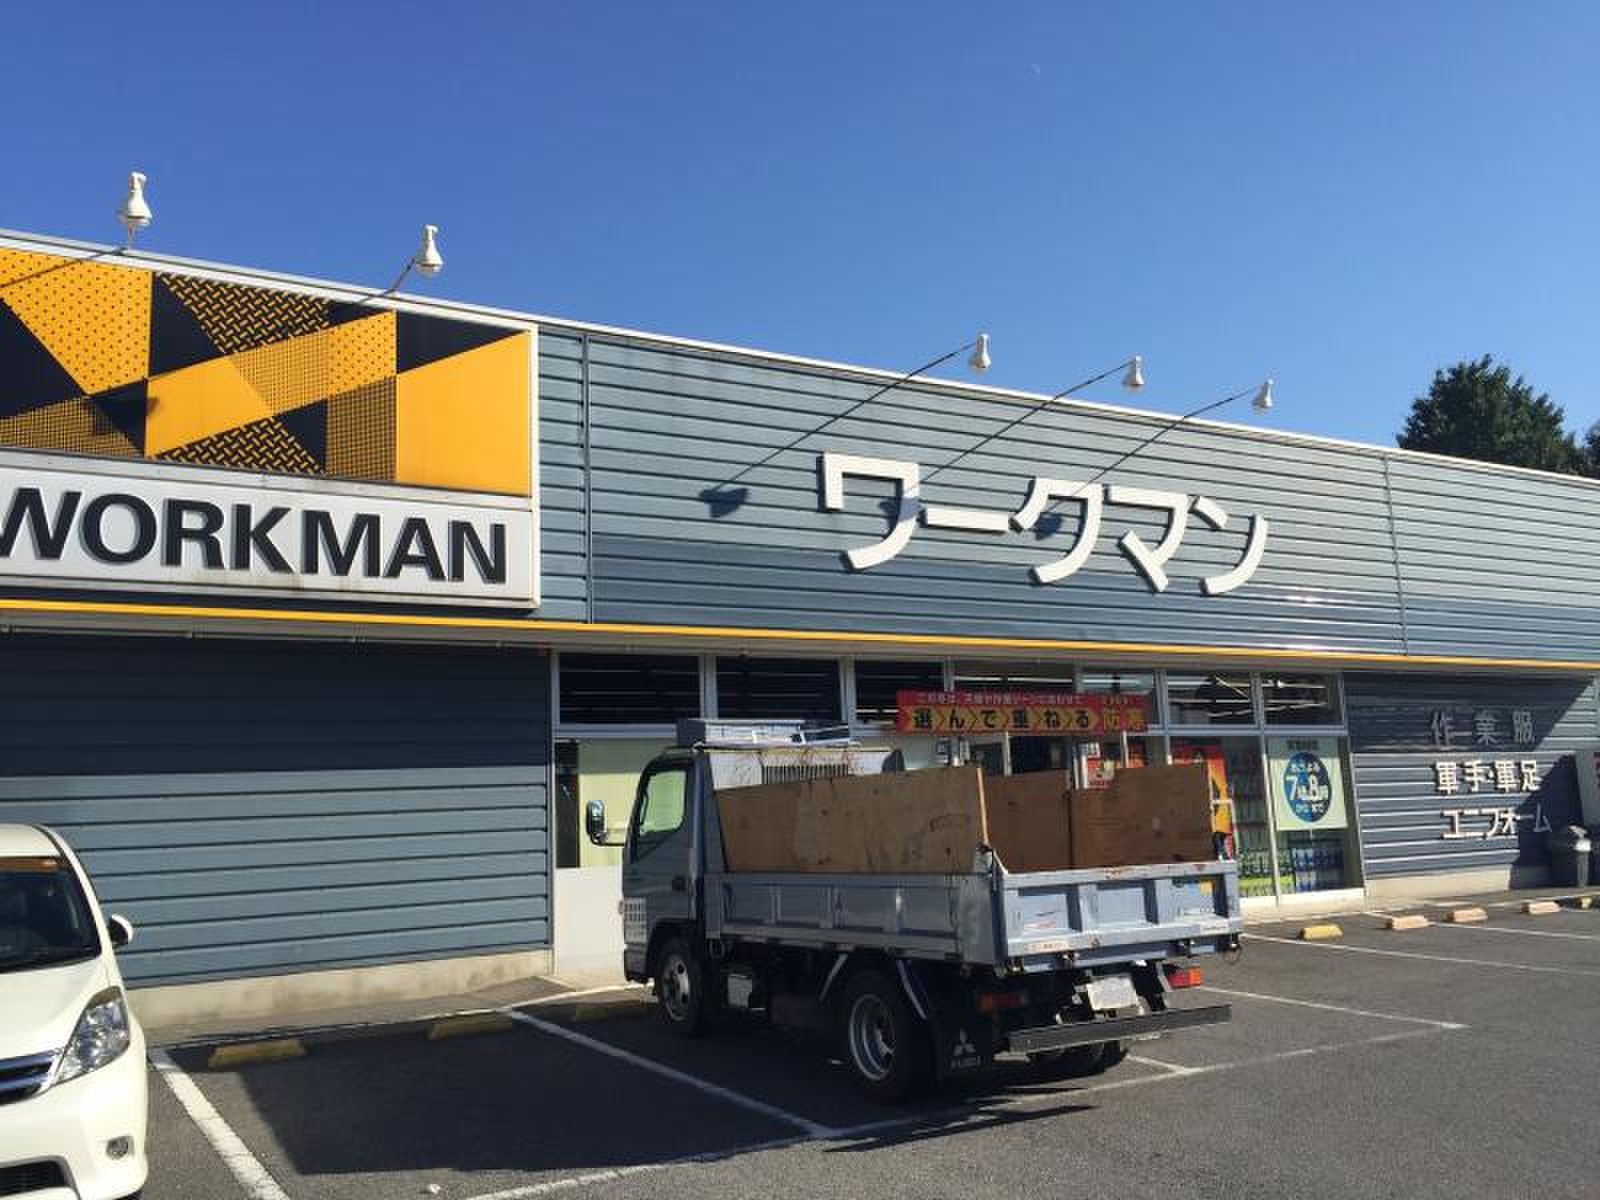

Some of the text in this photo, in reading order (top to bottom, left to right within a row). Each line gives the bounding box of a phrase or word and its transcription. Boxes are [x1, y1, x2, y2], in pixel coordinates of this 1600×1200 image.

[0, 487, 507, 585] WORKMAN
[819, 451, 1268, 594] ワークマン
[1430, 708, 1536, 745] 作業服
[1441, 801, 1553, 839] ユニフォーム
